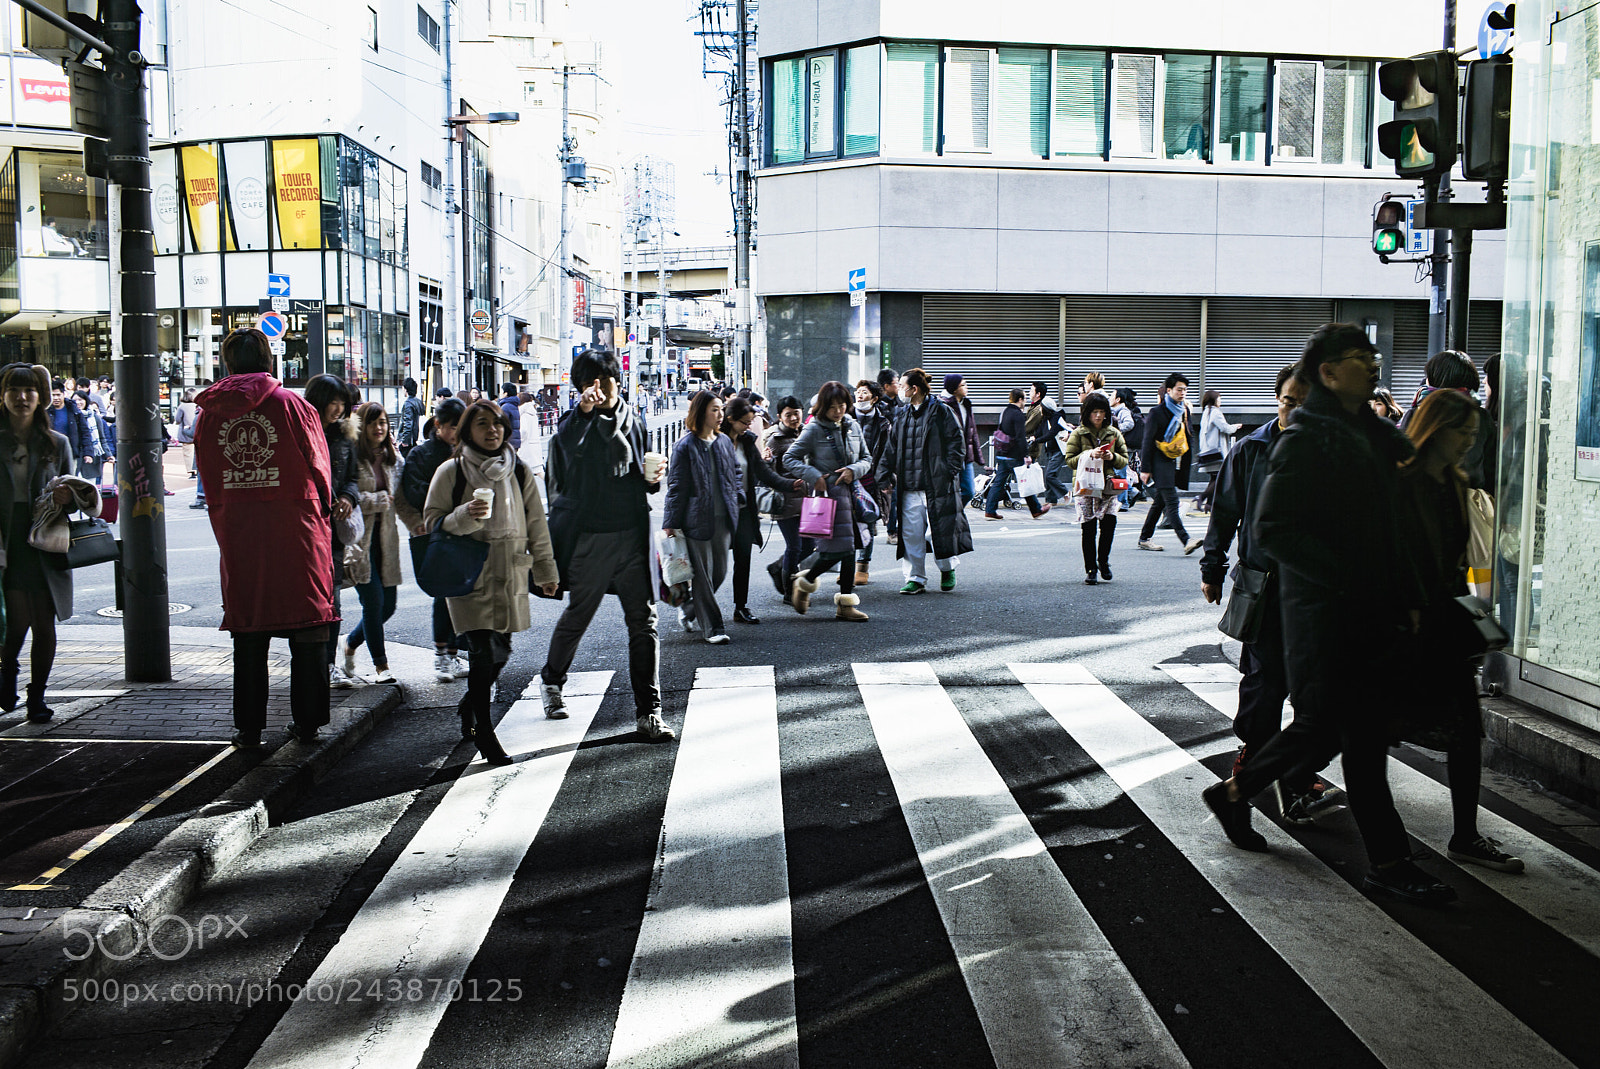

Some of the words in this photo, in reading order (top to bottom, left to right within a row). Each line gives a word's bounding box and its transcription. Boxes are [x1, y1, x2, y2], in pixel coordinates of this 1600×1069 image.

[190, 177, 217, 192] TOWER
[281, 173, 313, 187] TOWER
[279, 187, 320, 202] RECORDS
[241, 201, 264, 209] CAFE
[295, 209, 306, 220] 6F
[222, 467, 280, 483] ジャンカラ
